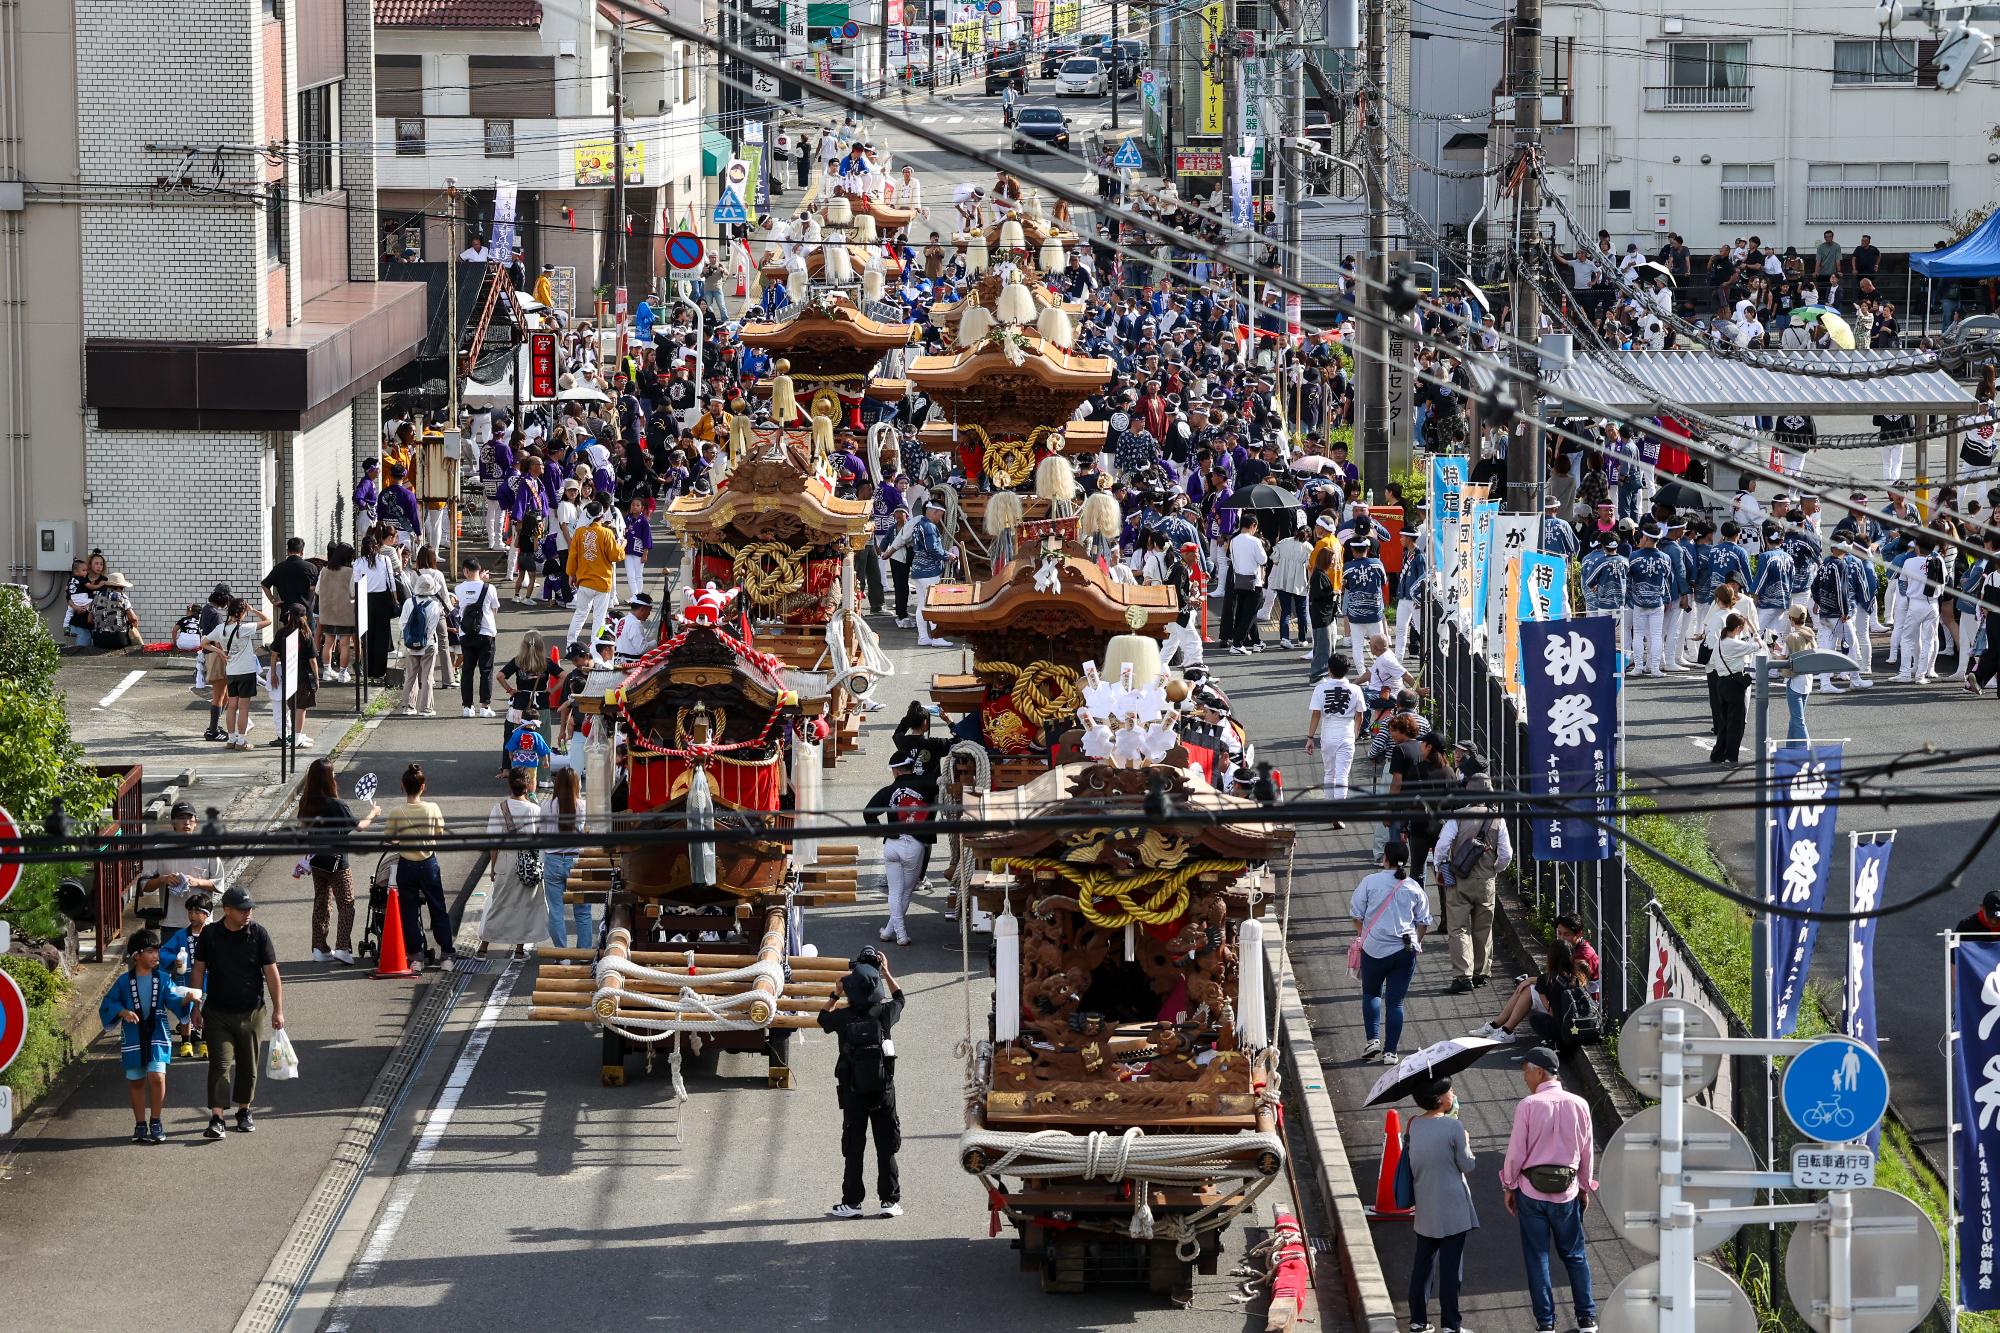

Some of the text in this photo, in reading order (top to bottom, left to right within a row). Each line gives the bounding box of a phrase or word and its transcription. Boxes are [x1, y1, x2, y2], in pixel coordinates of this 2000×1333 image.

[538, 337, 551, 394] 営業中
[1543, 630, 1599, 748] 秋祭
[1798, 1154, 1870, 1169] 自転車通行可
[1801, 1171, 1867, 1186] ここから
